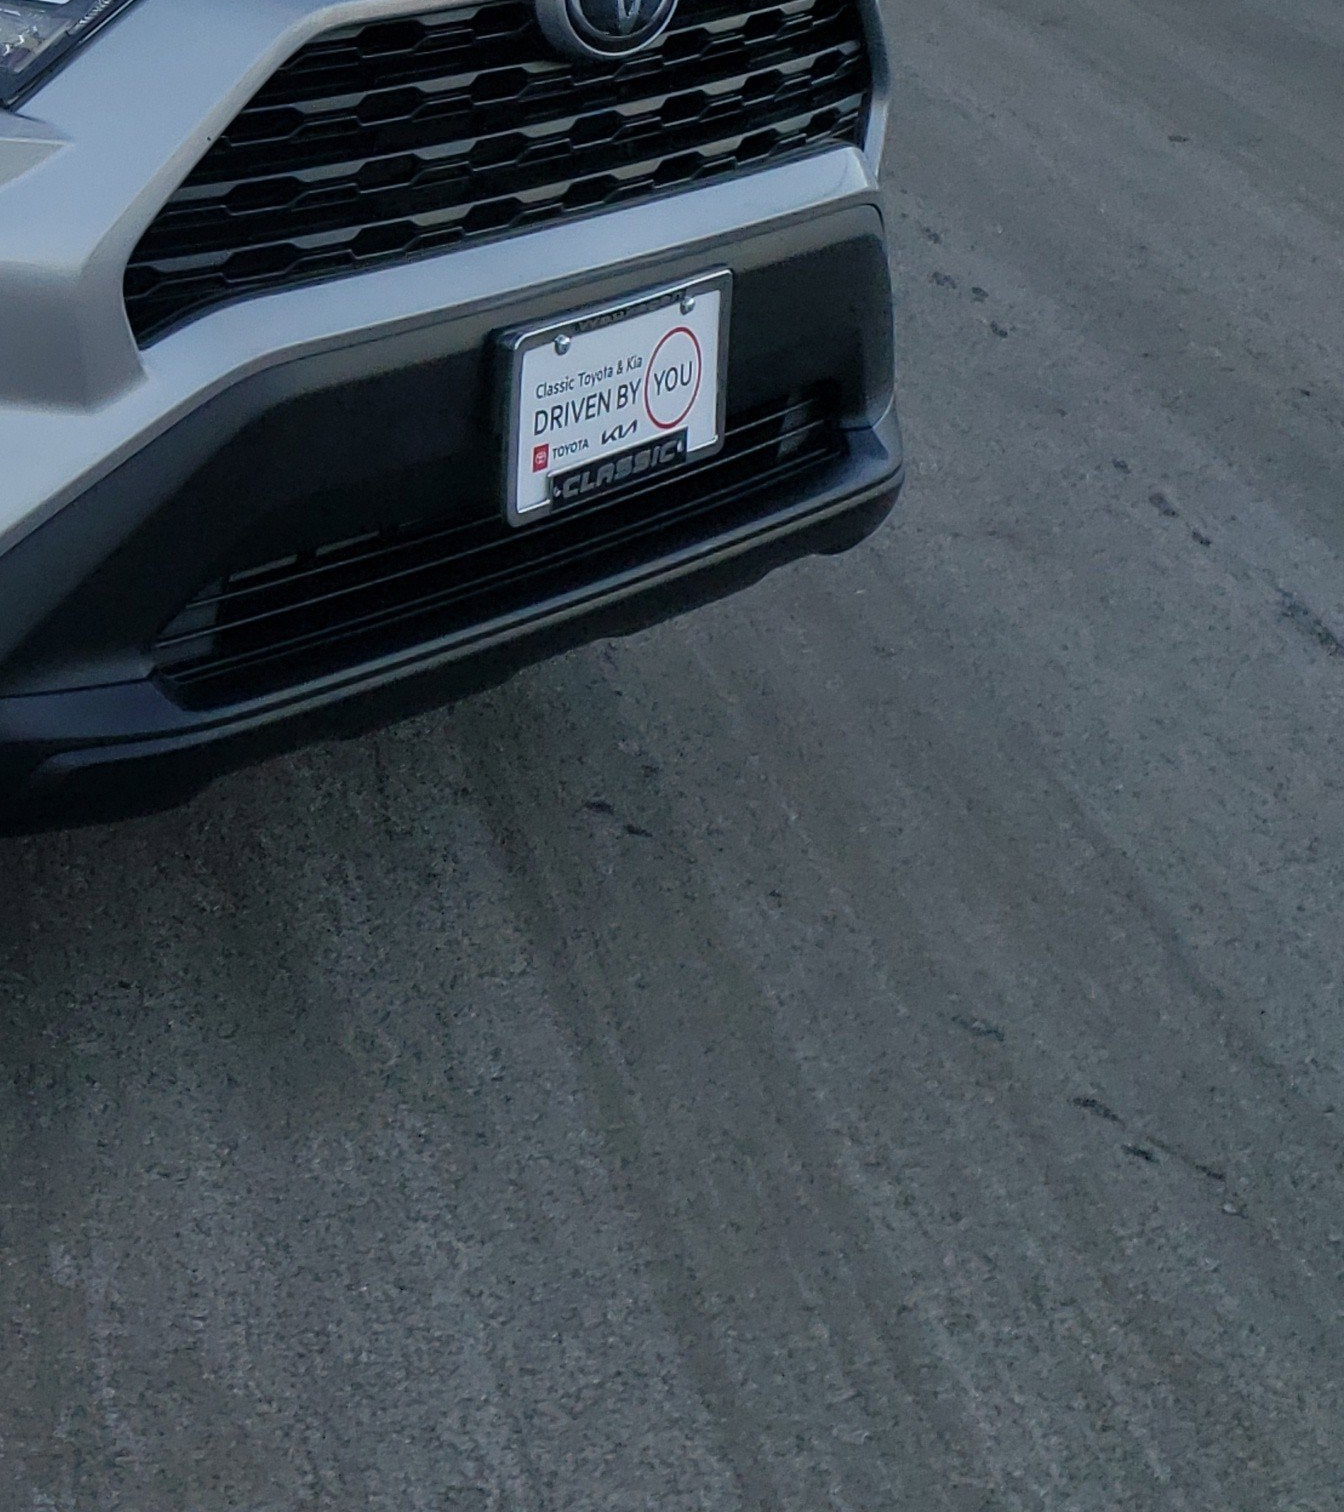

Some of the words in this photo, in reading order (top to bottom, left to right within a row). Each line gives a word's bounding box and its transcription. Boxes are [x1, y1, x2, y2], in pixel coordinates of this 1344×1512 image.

[533, 388, 612, 436] DRIVEN
[616, 377, 642, 410] BY
[653, 360, 693, 396] YOU
[535, 375, 575, 399] Classic
[578, 364, 613, 387] Toyota
[616, 359, 624, 374] &
[625, 354, 643, 373] Kia
[552, 437, 590, 460] TOYOTA
[561, 439, 678, 499] CLASSIC
